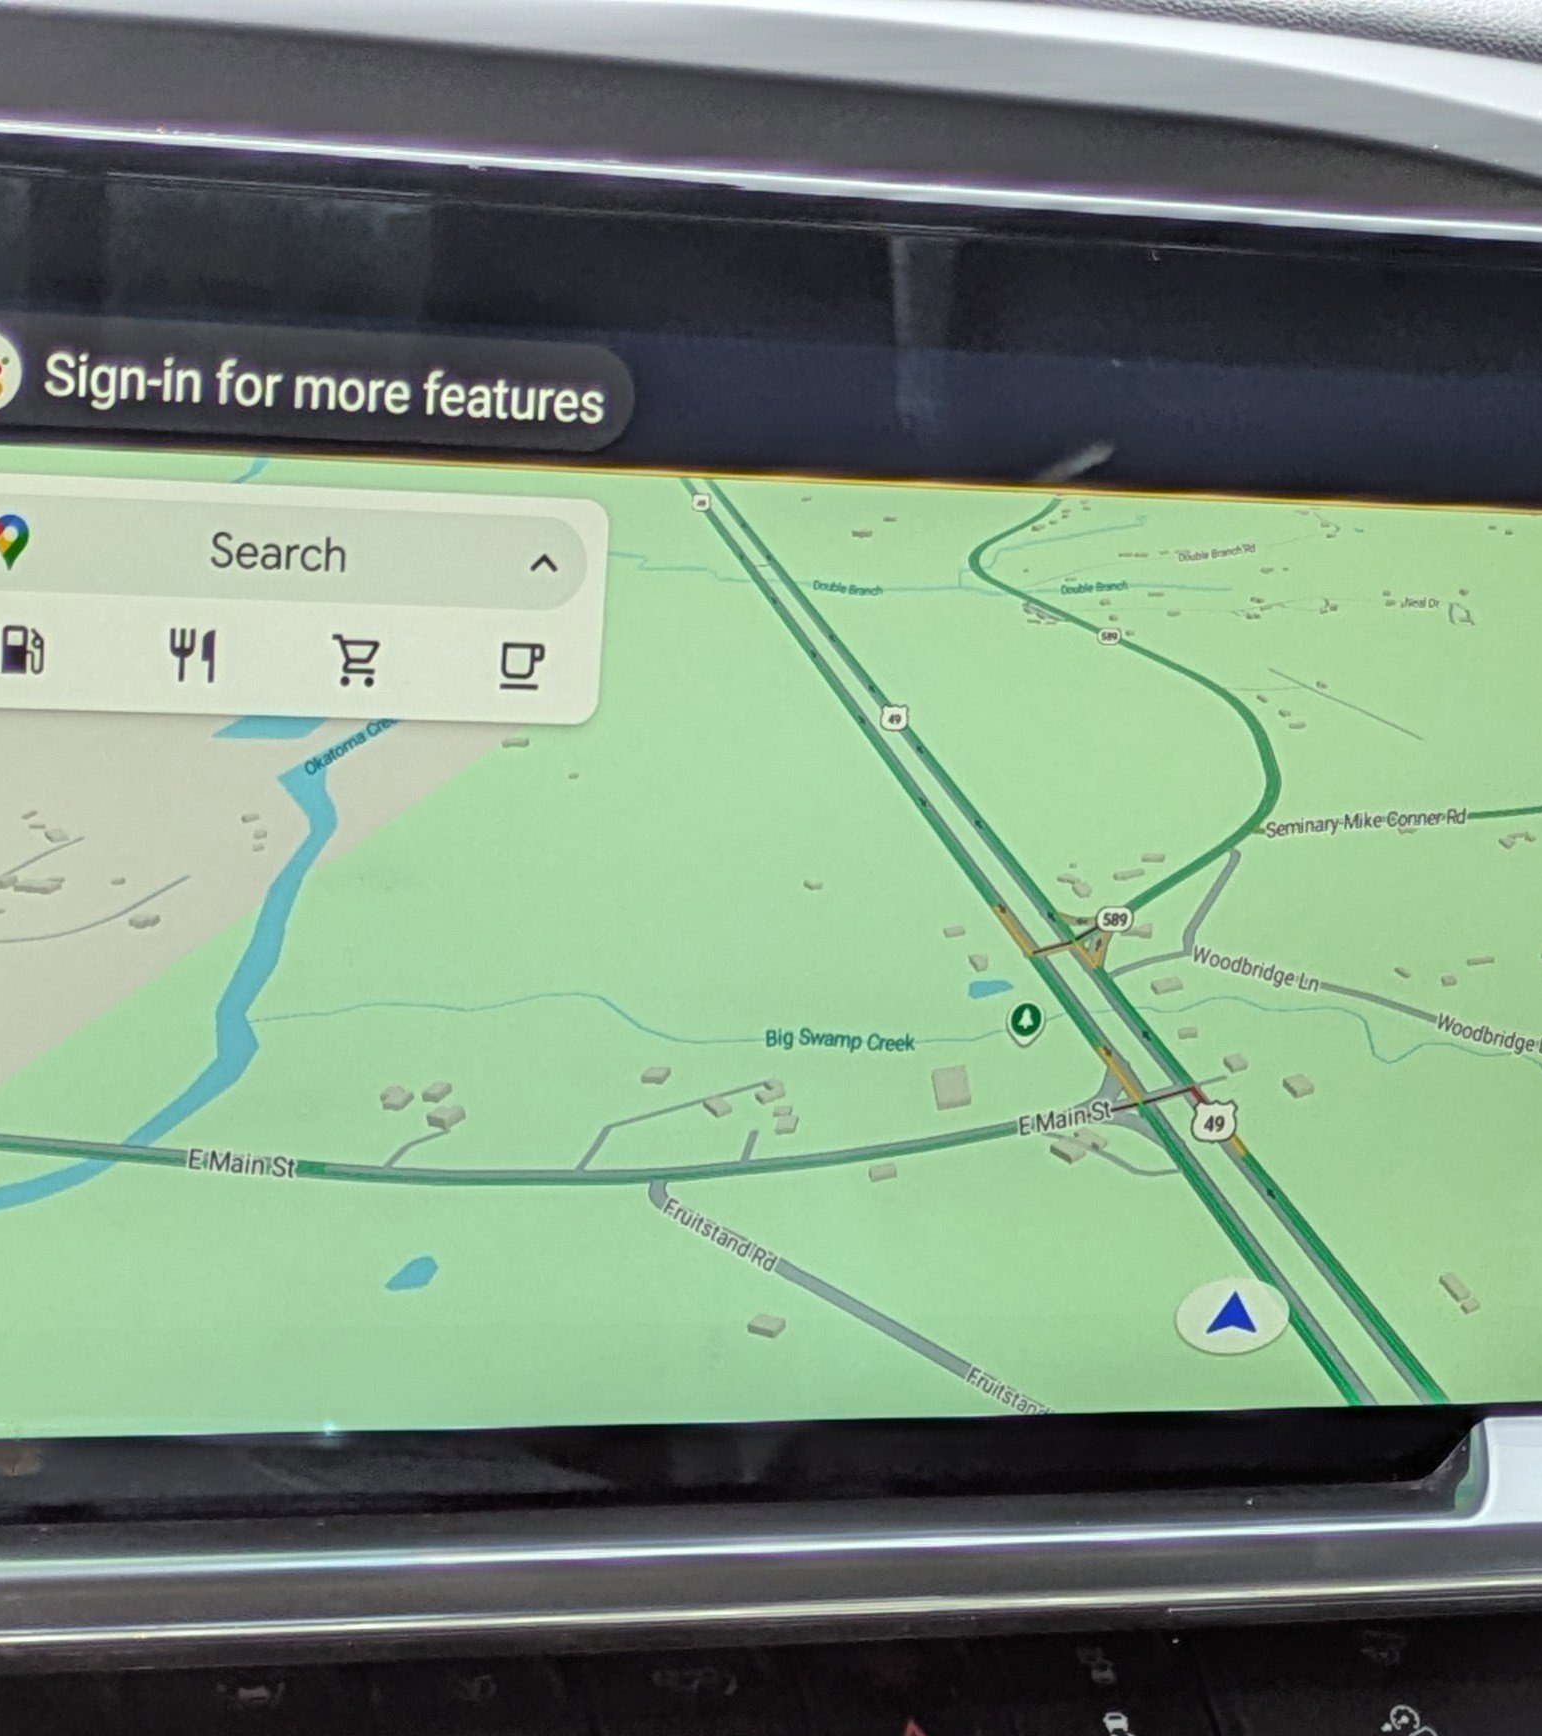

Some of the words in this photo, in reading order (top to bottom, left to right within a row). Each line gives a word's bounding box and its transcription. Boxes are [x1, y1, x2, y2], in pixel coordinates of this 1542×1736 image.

[44, 352, 201, 410] Sign-in
[216, 356, 282, 408] for
[293, 378, 411, 416] more
[422, 370, 605, 425] features
[210, 531, 346, 573] Search
[813, 580, 847, 594] Double
[848, 584, 884, 597] Branch
[1061, 583, 1094, 595] Double
[1095, 580, 1129, 592] Branch
[888, 713, 902, 725] 49
[304, 731, 367, 775] Okatoma
[1387, 811, 1443, 827] Conner
[1447, 808, 1467, 825] Rd
[1102, 912, 1128, 927] 589
[1193, 945, 1295, 988] Woodbridge
[1299, 972, 1321, 992] Ln
[765, 1028, 794, 1050] Big
[799, 1027, 862, 1053] Swamp
[867, 1032, 916, 1051] Creek
[1438, 1012, 1535, 1055] Woodbridge
[1019, 1115, 1031, 1136] E
[1036, 1108, 1086, 1132] Main
[1091, 1101, 1111, 1122] St
[1203, 1115, 1225, 1132] 49
[188, 1148, 203, 1170] E
[209, 1150, 265, 1175] Main
[272, 1156, 296, 1178] St
[663, 1197, 753, 1258] Fruitstand
[751, 1245, 778, 1272] Rd
